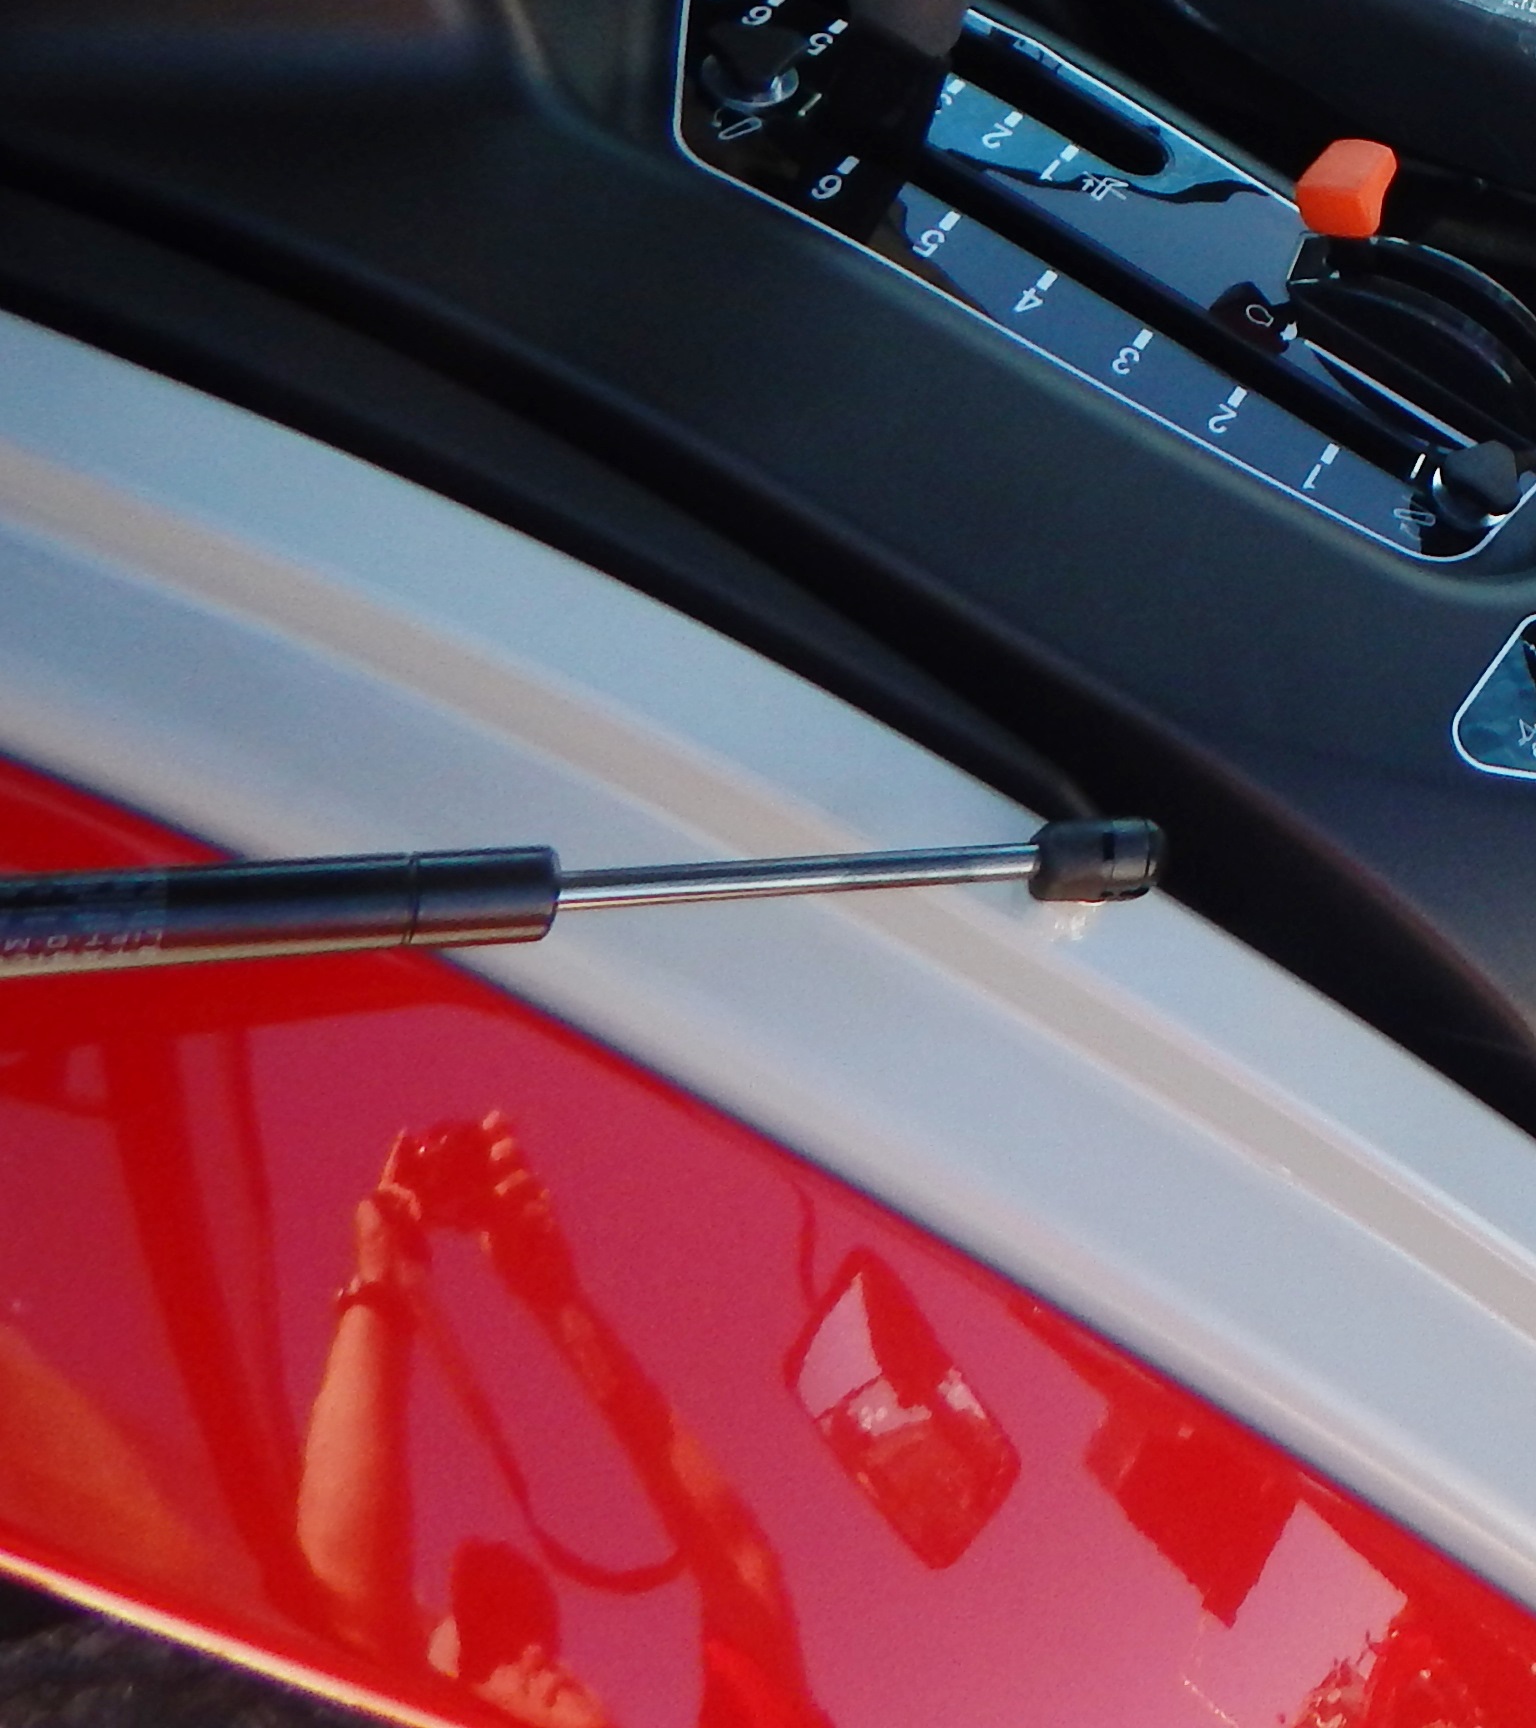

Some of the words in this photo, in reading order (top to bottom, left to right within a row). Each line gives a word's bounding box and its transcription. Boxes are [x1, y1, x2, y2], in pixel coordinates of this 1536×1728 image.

[741, 5, 773, 26] 6
[806, 32, 834, 57] 5
[981, 121, 1014, 149] 2
[1040, 159, 1063, 182] 1
[810, 174, 843, 200] 6
[912, 228, 946, 258] 5
[1013, 288, 1045, 314] 4
[1111, 347, 1142, 375] 3
[1208, 403, 1238, 434] 2
[1301, 463, 1323, 490] 1
